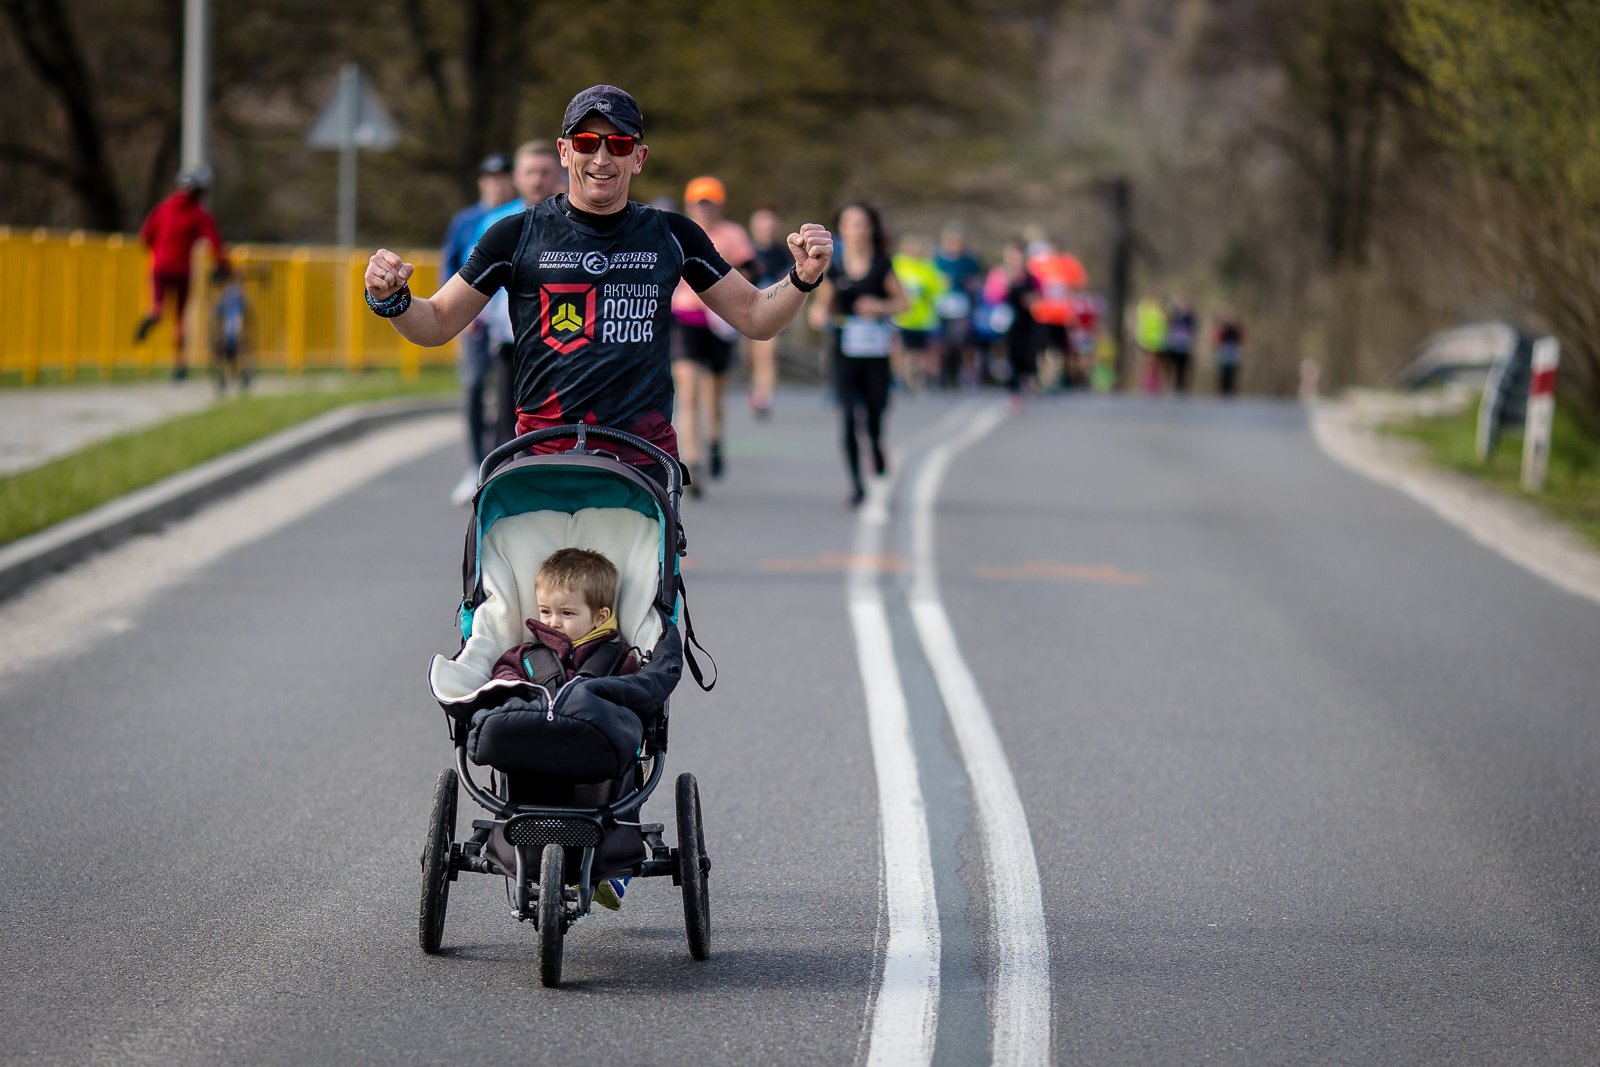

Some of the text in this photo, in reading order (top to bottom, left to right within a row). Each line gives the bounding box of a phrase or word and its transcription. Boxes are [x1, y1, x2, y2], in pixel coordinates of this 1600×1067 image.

[539, 251, 583, 262] HUSKY
[611, 252, 658, 262] EXPRESS
[603, 284, 658, 297] AKTYWNA
[603, 298, 658, 319] NOWA
[602, 320, 654, 343] RUDA
